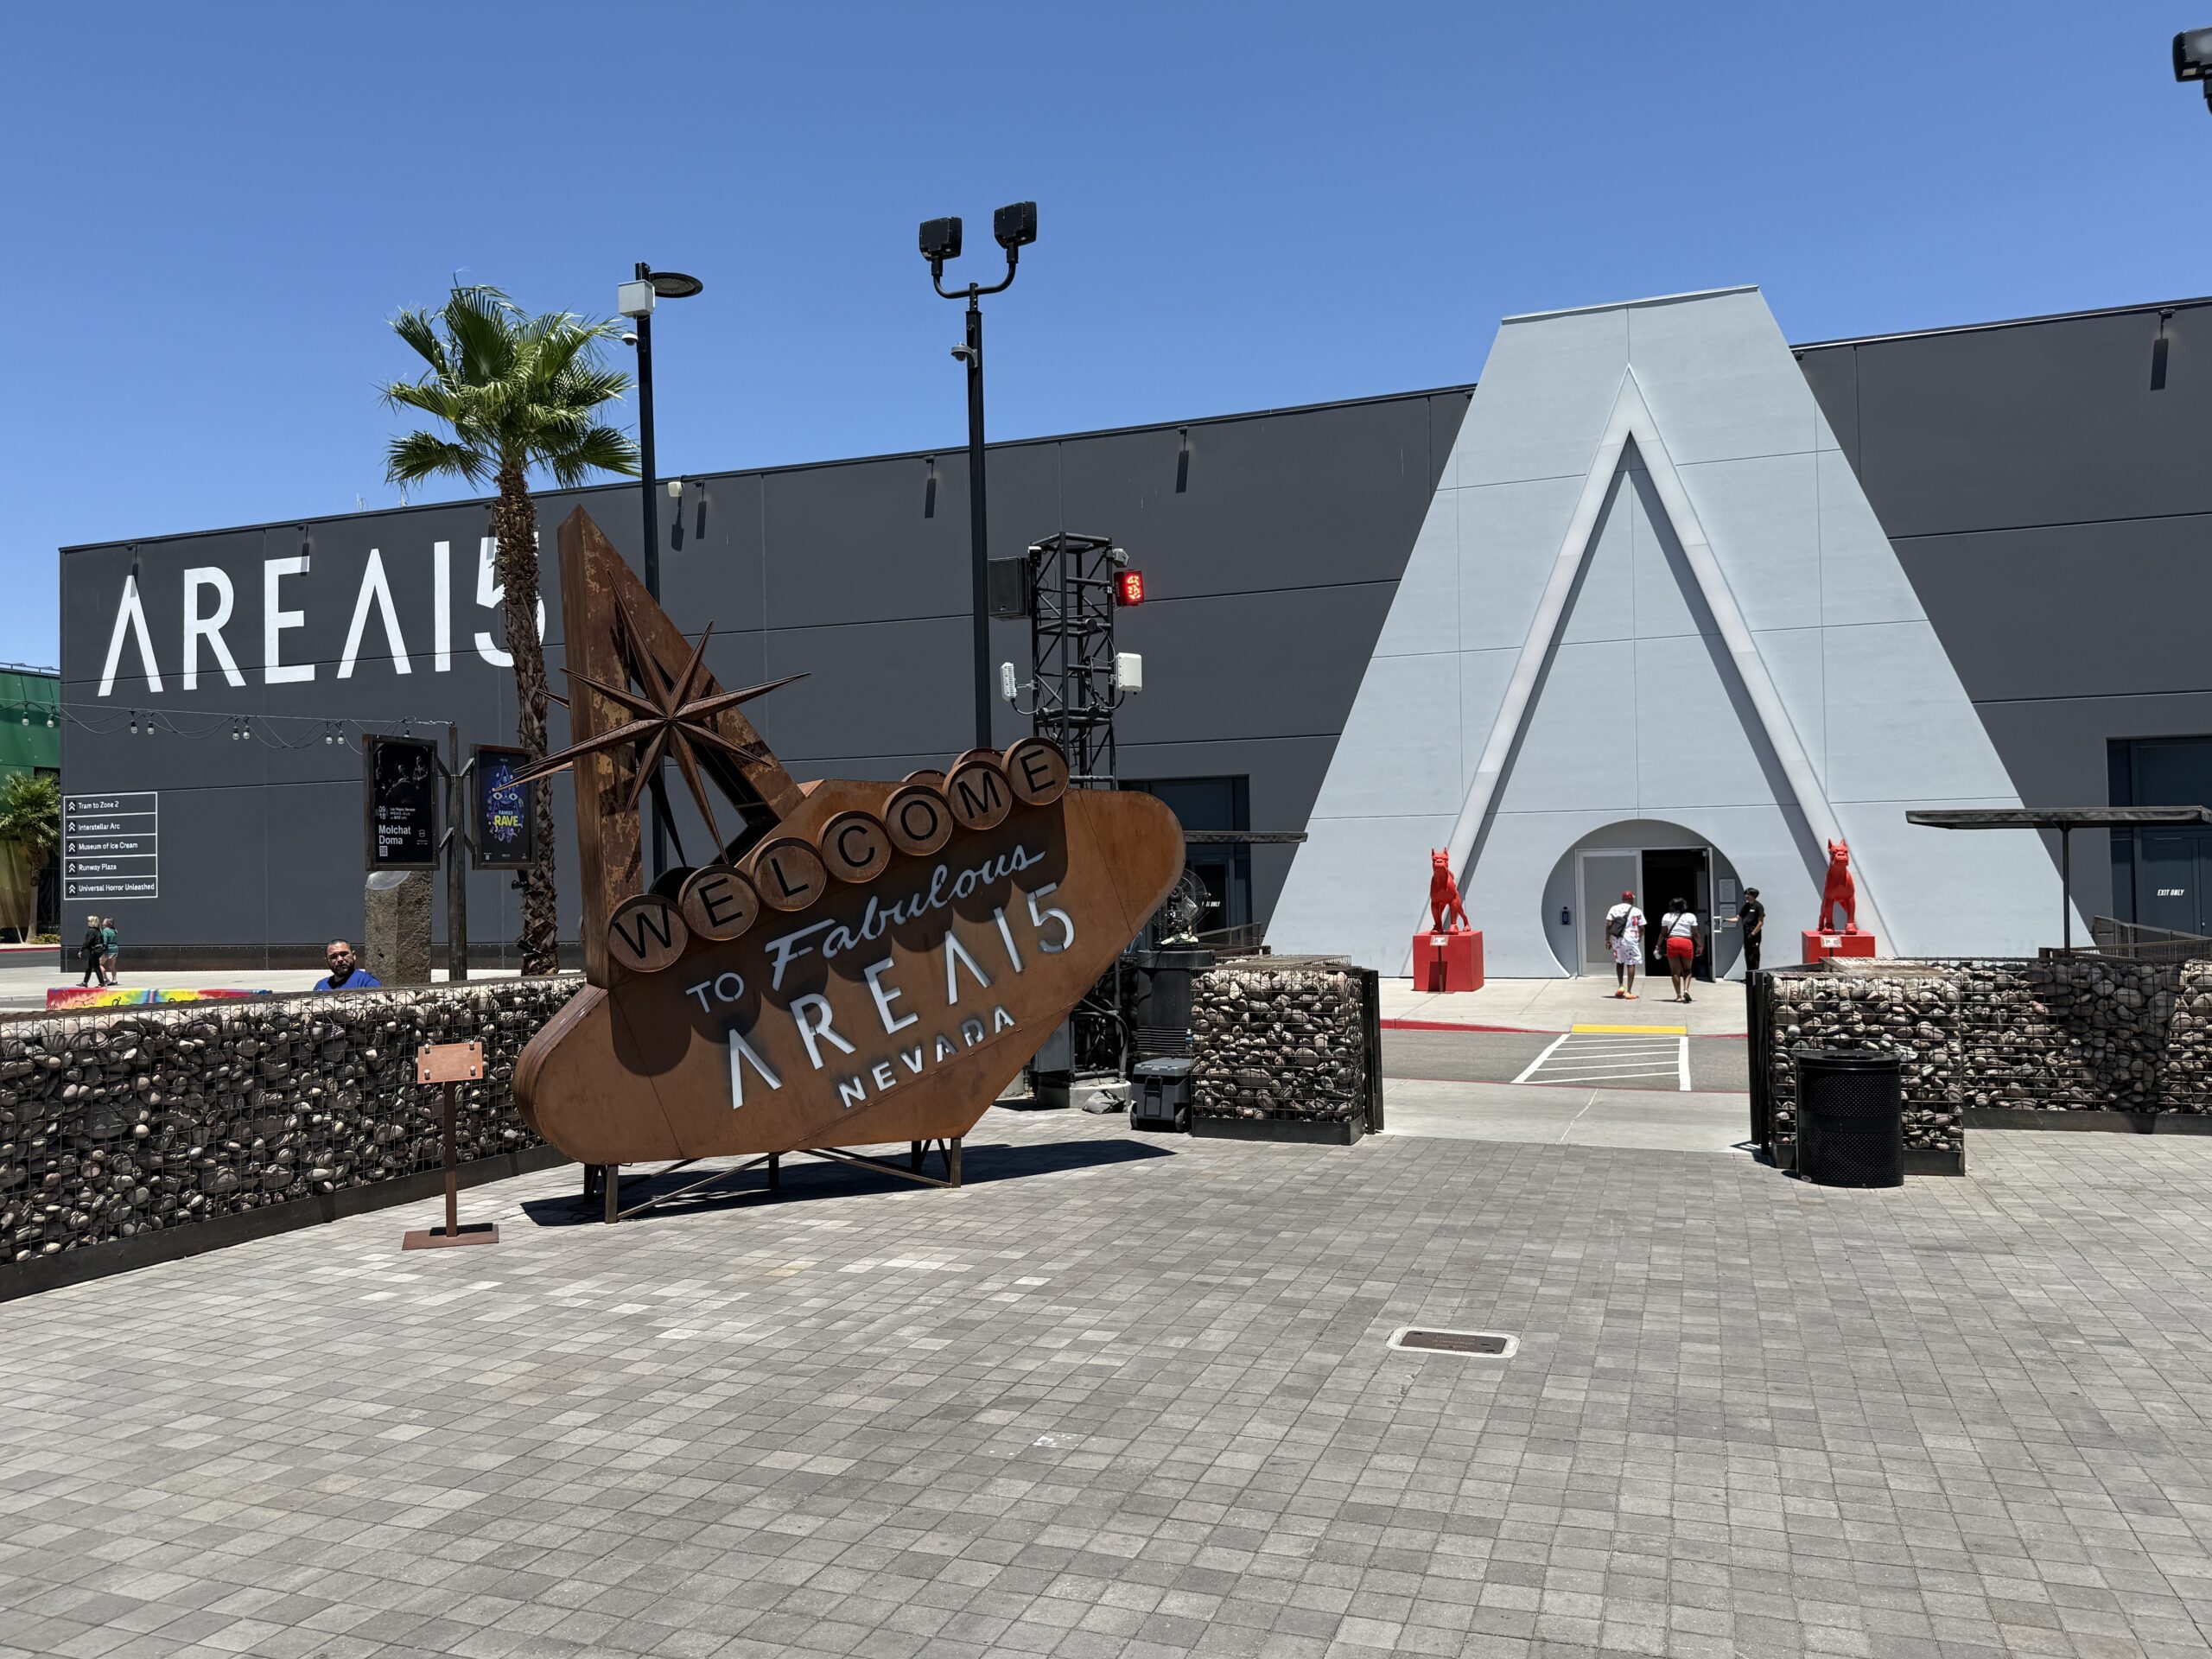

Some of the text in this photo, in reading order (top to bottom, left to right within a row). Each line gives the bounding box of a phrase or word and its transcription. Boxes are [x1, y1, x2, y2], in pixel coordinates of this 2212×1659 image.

[98, 531, 546, 696] AREA15
[78, 823, 109, 831] Interstellar
[493, 815, 519, 827] RAVE
[378, 824, 411, 835] Molchat
[378, 835, 404, 845] Doma
[613, 748, 1058, 960] WELCOME
[79, 863, 100, 872] Runway
[105, 883, 124, 892] Horror
[124, 882, 155, 891] Unleashed
[685, 843, 1046, 1014] TO Fabulous
[728, 881, 1077, 1110] AREA15
[838, 1005, 1017, 1109] NEVADA
